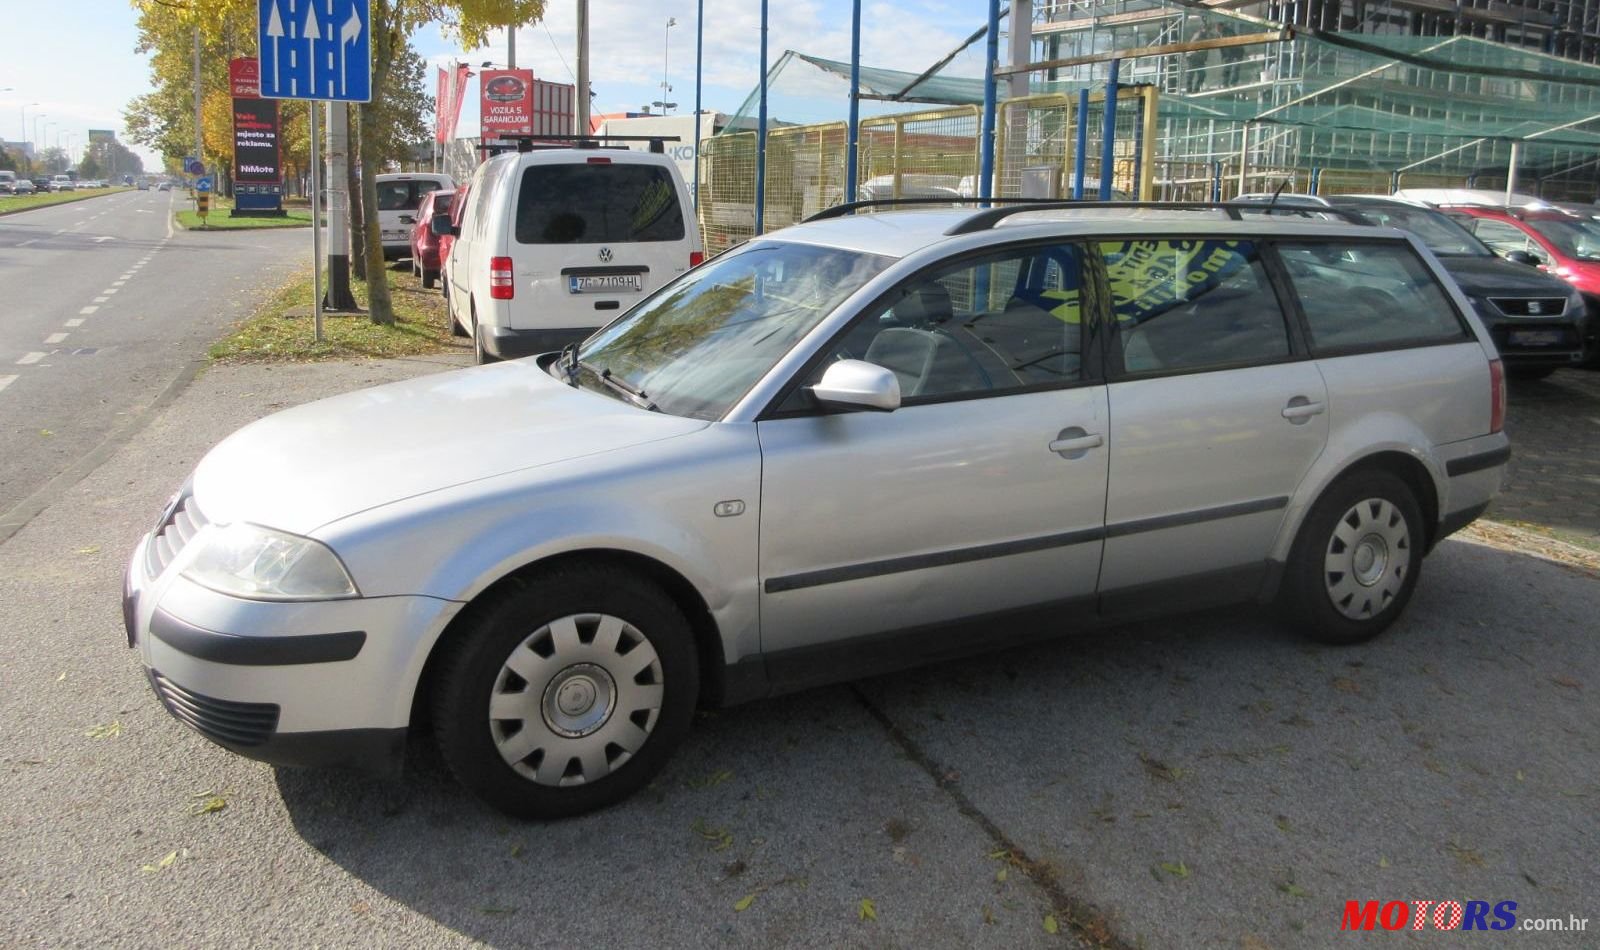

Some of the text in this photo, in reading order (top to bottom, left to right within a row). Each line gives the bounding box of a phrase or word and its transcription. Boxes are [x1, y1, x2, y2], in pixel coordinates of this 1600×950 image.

[490, 106, 522, 114] VOZILA S
[484, 115, 528, 123] GARANCIJOM
[579, 278, 592, 290] ZG
